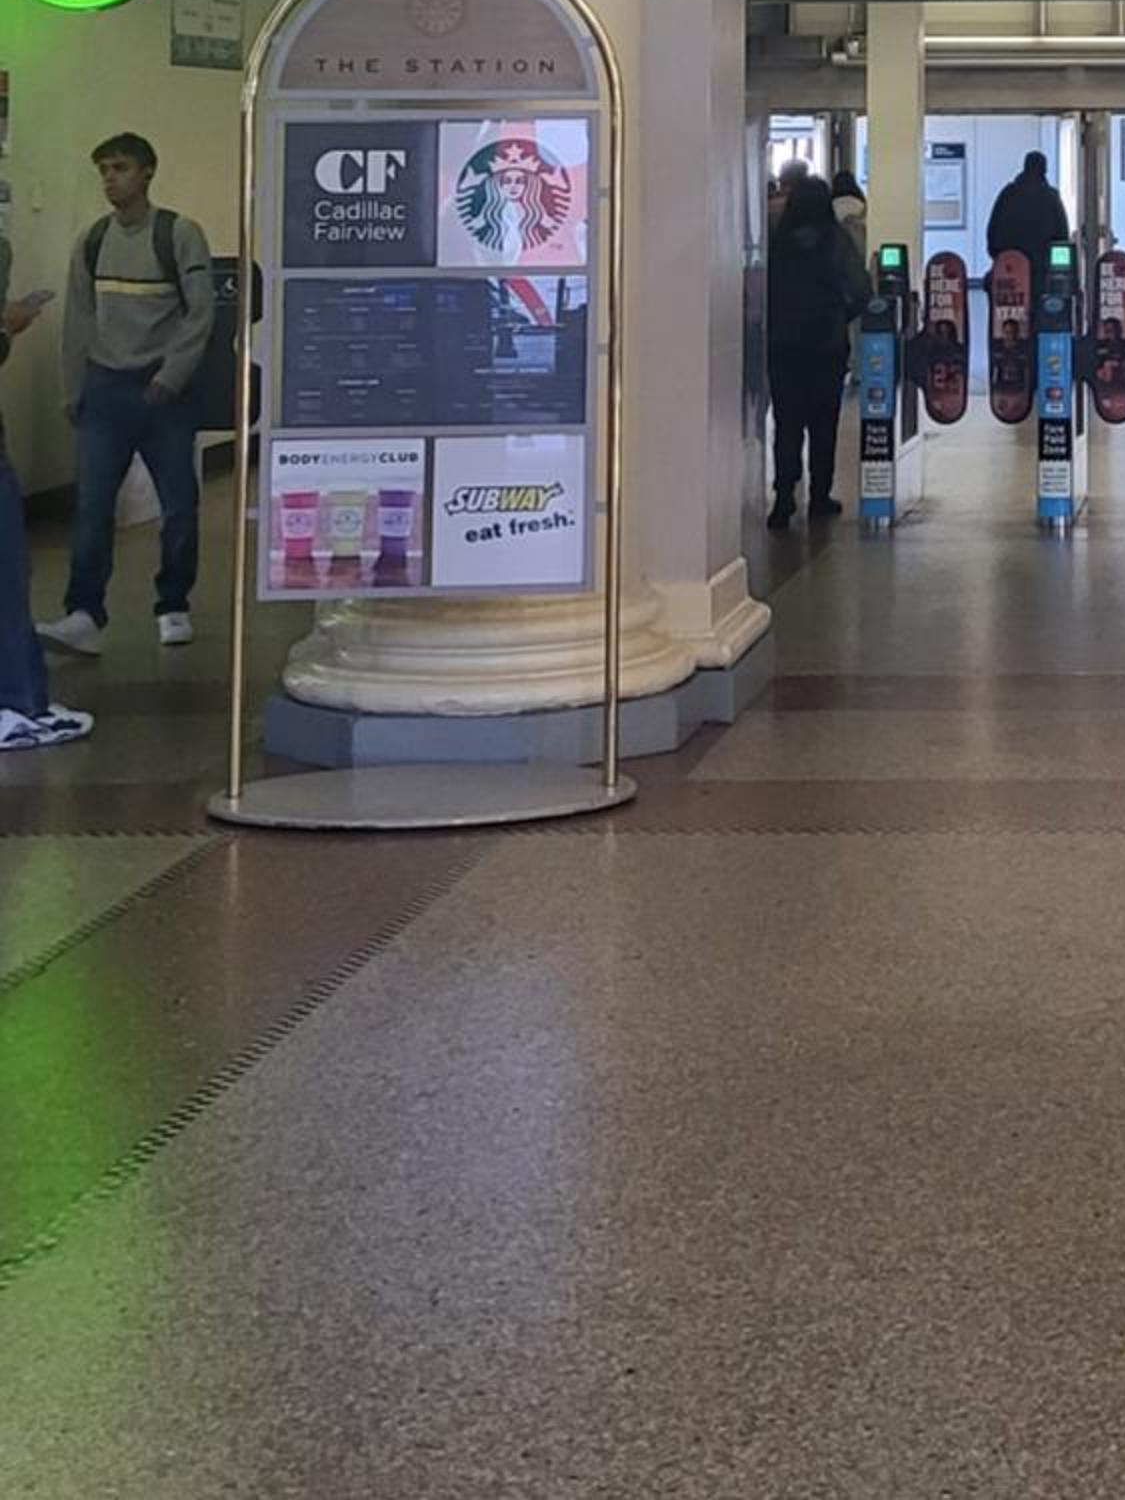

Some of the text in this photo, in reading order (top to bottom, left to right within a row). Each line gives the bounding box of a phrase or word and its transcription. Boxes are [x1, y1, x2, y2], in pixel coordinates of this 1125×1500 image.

[315, 58, 556, 74] THE STATION
[314, 149, 406, 194] CF
[313, 201, 406, 221] Cadillac
[313, 222, 406, 242] Fairview
[444, 482, 564, 516] SUBWAY
[464, 522, 503, 543] eat
